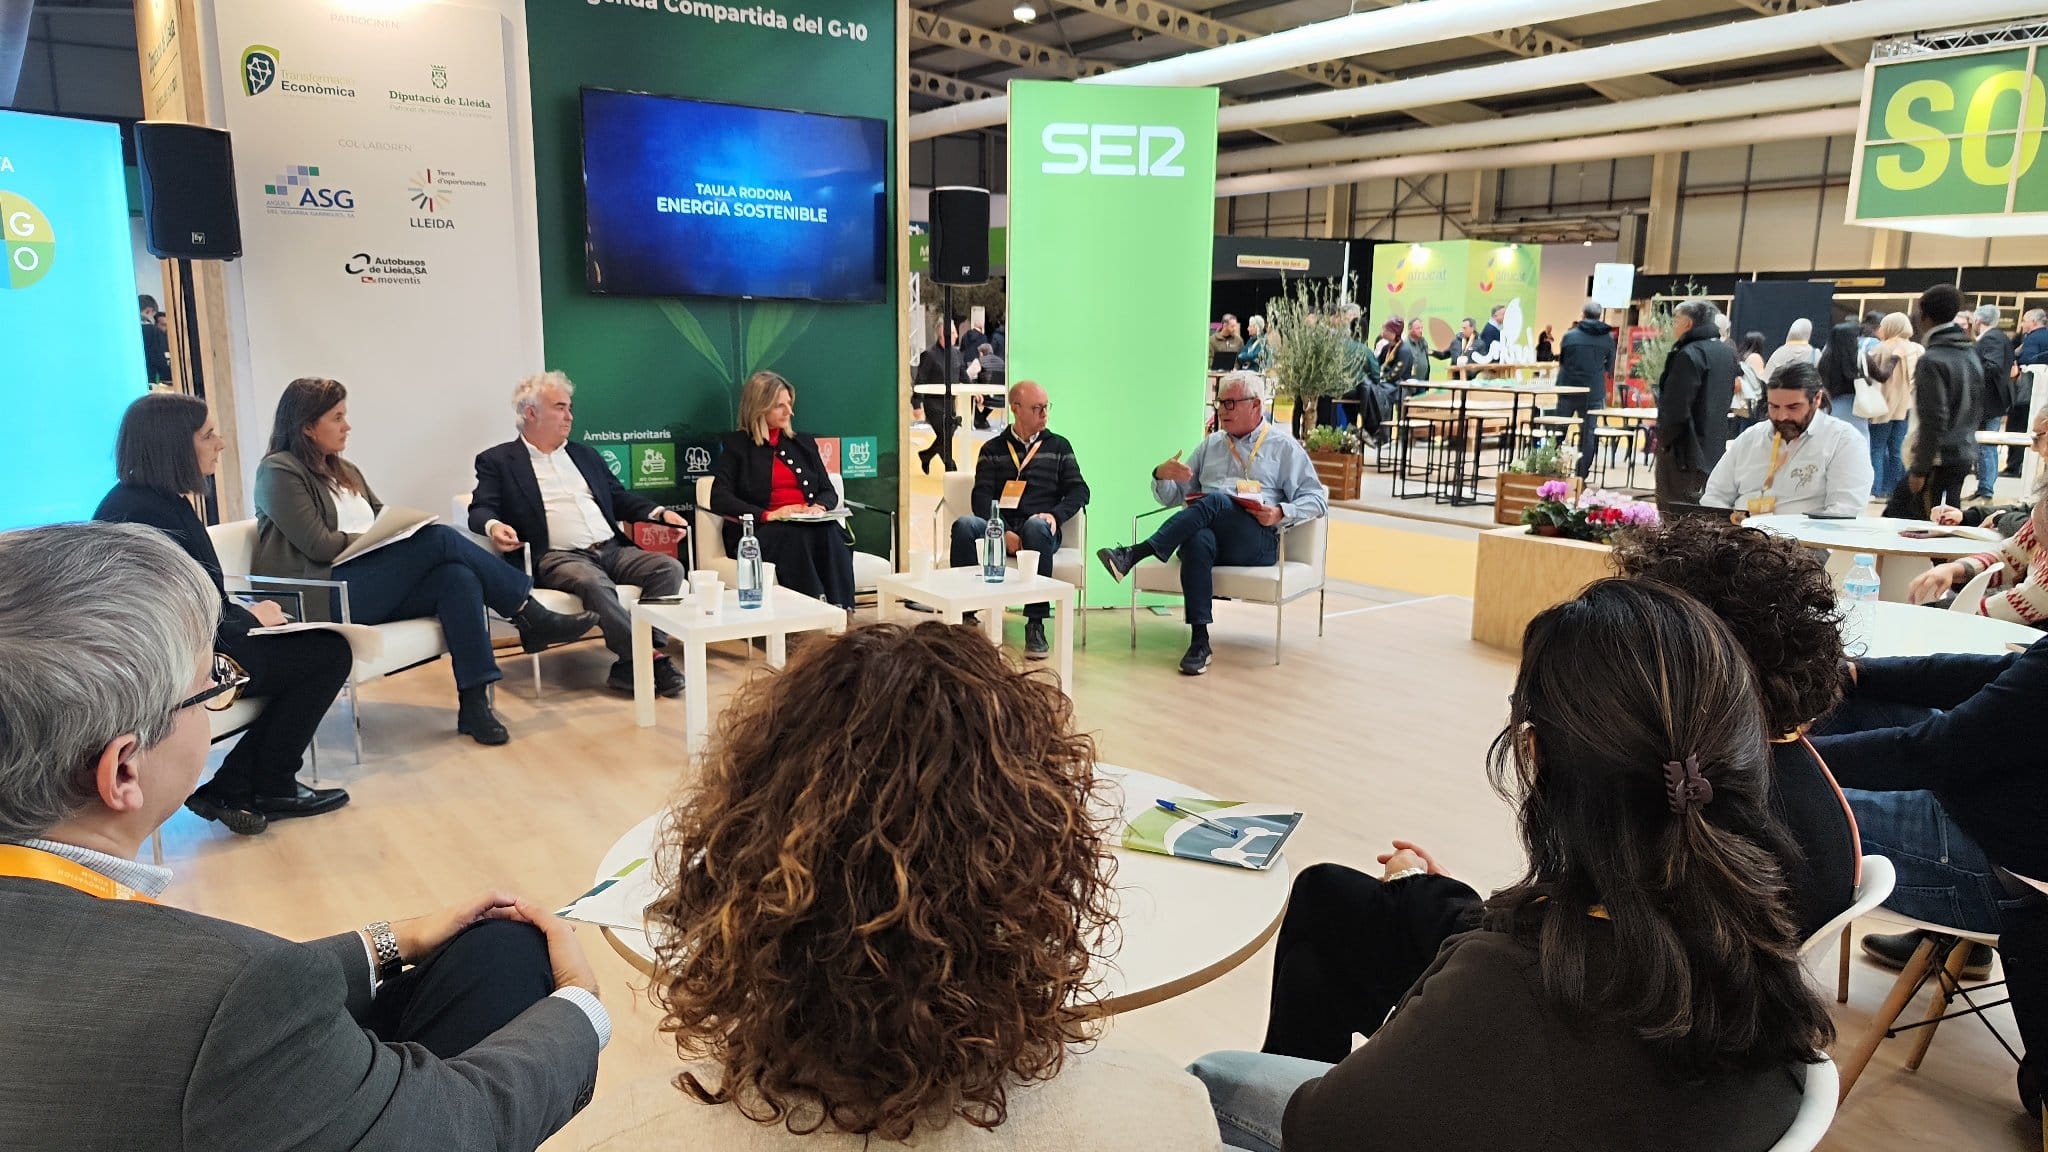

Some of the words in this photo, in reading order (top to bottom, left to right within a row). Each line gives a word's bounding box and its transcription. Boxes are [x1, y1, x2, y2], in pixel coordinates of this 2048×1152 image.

[663, 0, 788, 30] Compartida
[793, 14, 823, 35] del
[828, 21, 868, 41] G-10
[281, 80, 356, 98] Econòmica
[389, 90, 441, 104] Diputació
[443, 95, 456, 106] de
[458, 97, 492, 109] Lleida
[1876, 70, 2047, 191] SO
[1041, 123, 1186, 177] SER
[299, 187, 354, 209] ASG
[696, 183, 737, 199] TAULA
[739, 186, 792, 202] RODONA
[734, 203, 828, 223] SOSTENIBLE
[409, 217, 455, 230] LLEIDA
[369, 266, 381, 274] de
[375, 257, 426, 267] Autobusos
[378, 276, 421, 285] moventis
[583, 429, 621, 441] Àmbits
[623, 429, 672, 442] prioritaris
